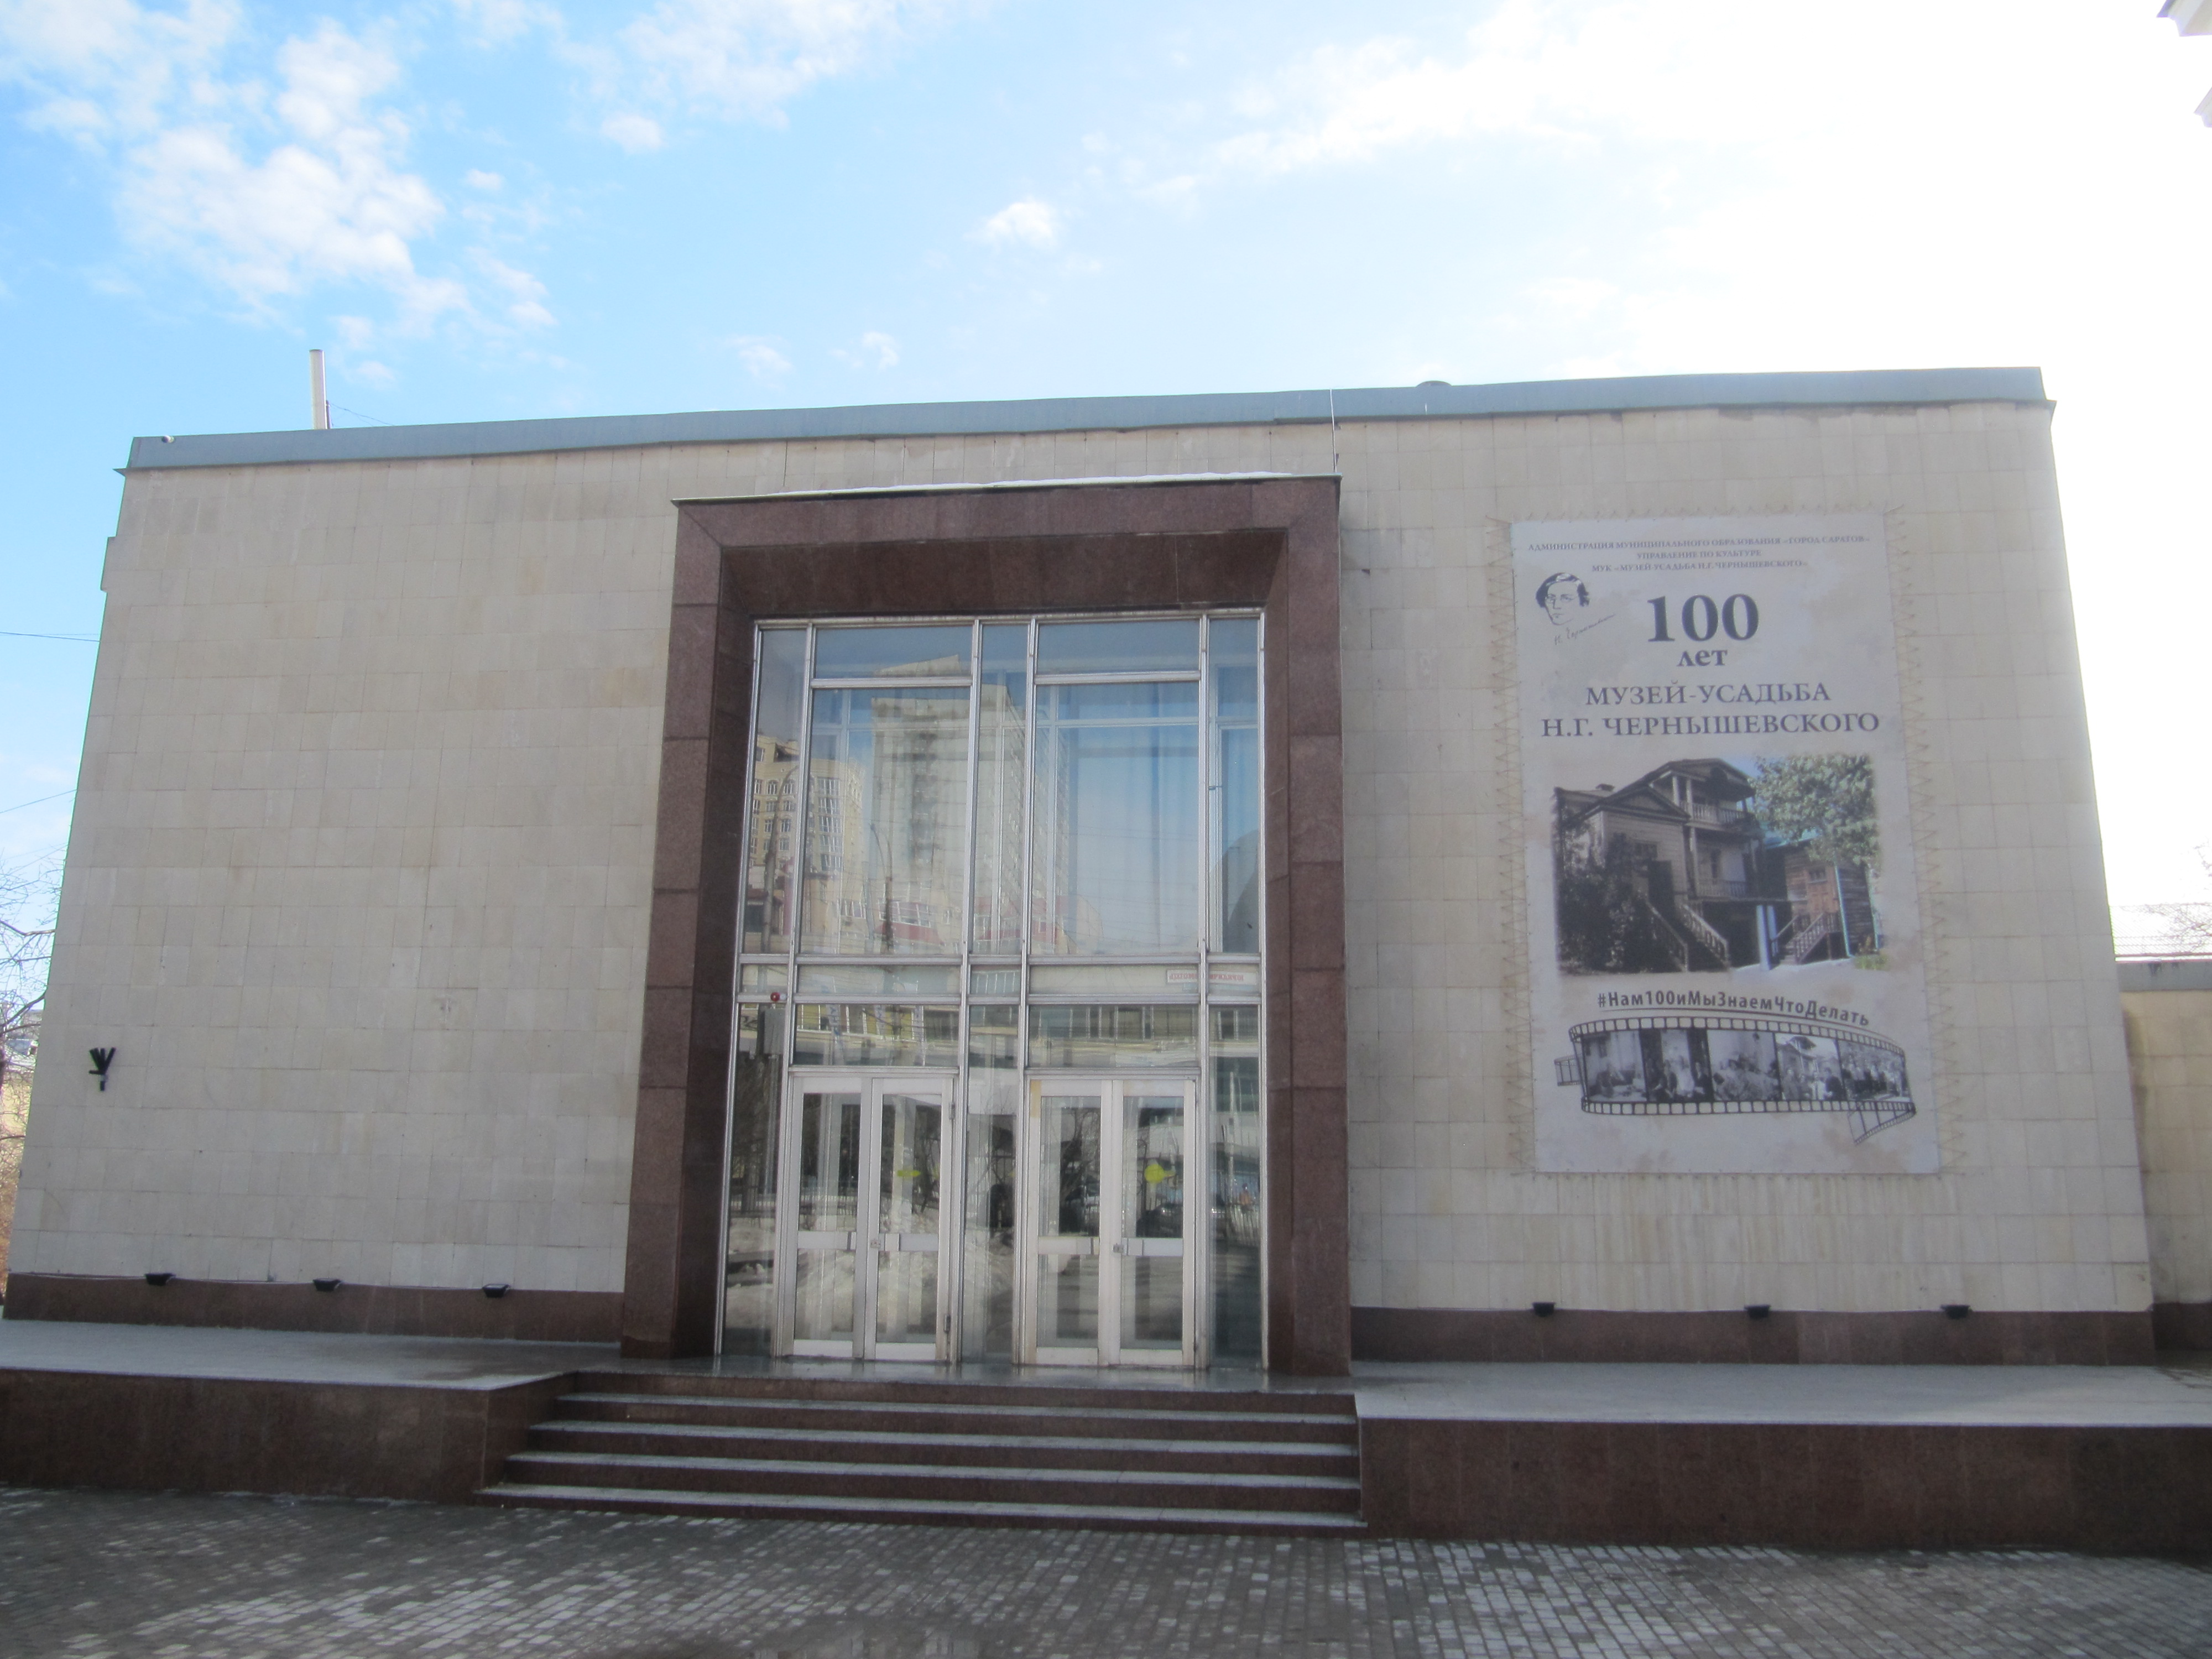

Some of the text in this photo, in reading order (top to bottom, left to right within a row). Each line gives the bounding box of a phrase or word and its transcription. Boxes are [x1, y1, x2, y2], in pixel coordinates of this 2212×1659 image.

[1528, 542, 1614, 552] АДМИНИСТРАЦИЯ
[1616, 540, 1710, 549] МУНИЦИПАЛЬНОГО
[1712, 538, 1781, 546] ОБРАЗОВАНИЯ
[1637, 551, 1698, 560] УПРАВЛЕНИЕ
[1715, 549, 1762, 558] КУЛЬТУРЕ
[1647, 593, 1759, 642] 100
[1677, 648, 1728, 667] лет
[1585, 680, 1831, 706] МУЗЕЙ-УСАДЬБА
[1541, 712, 1880, 737] Н.Г. ЧЕРНЫШЕВСКОГО
[1597, 989, 1870, 1027] #Нам100иМыЗнаемЧтоДелать
